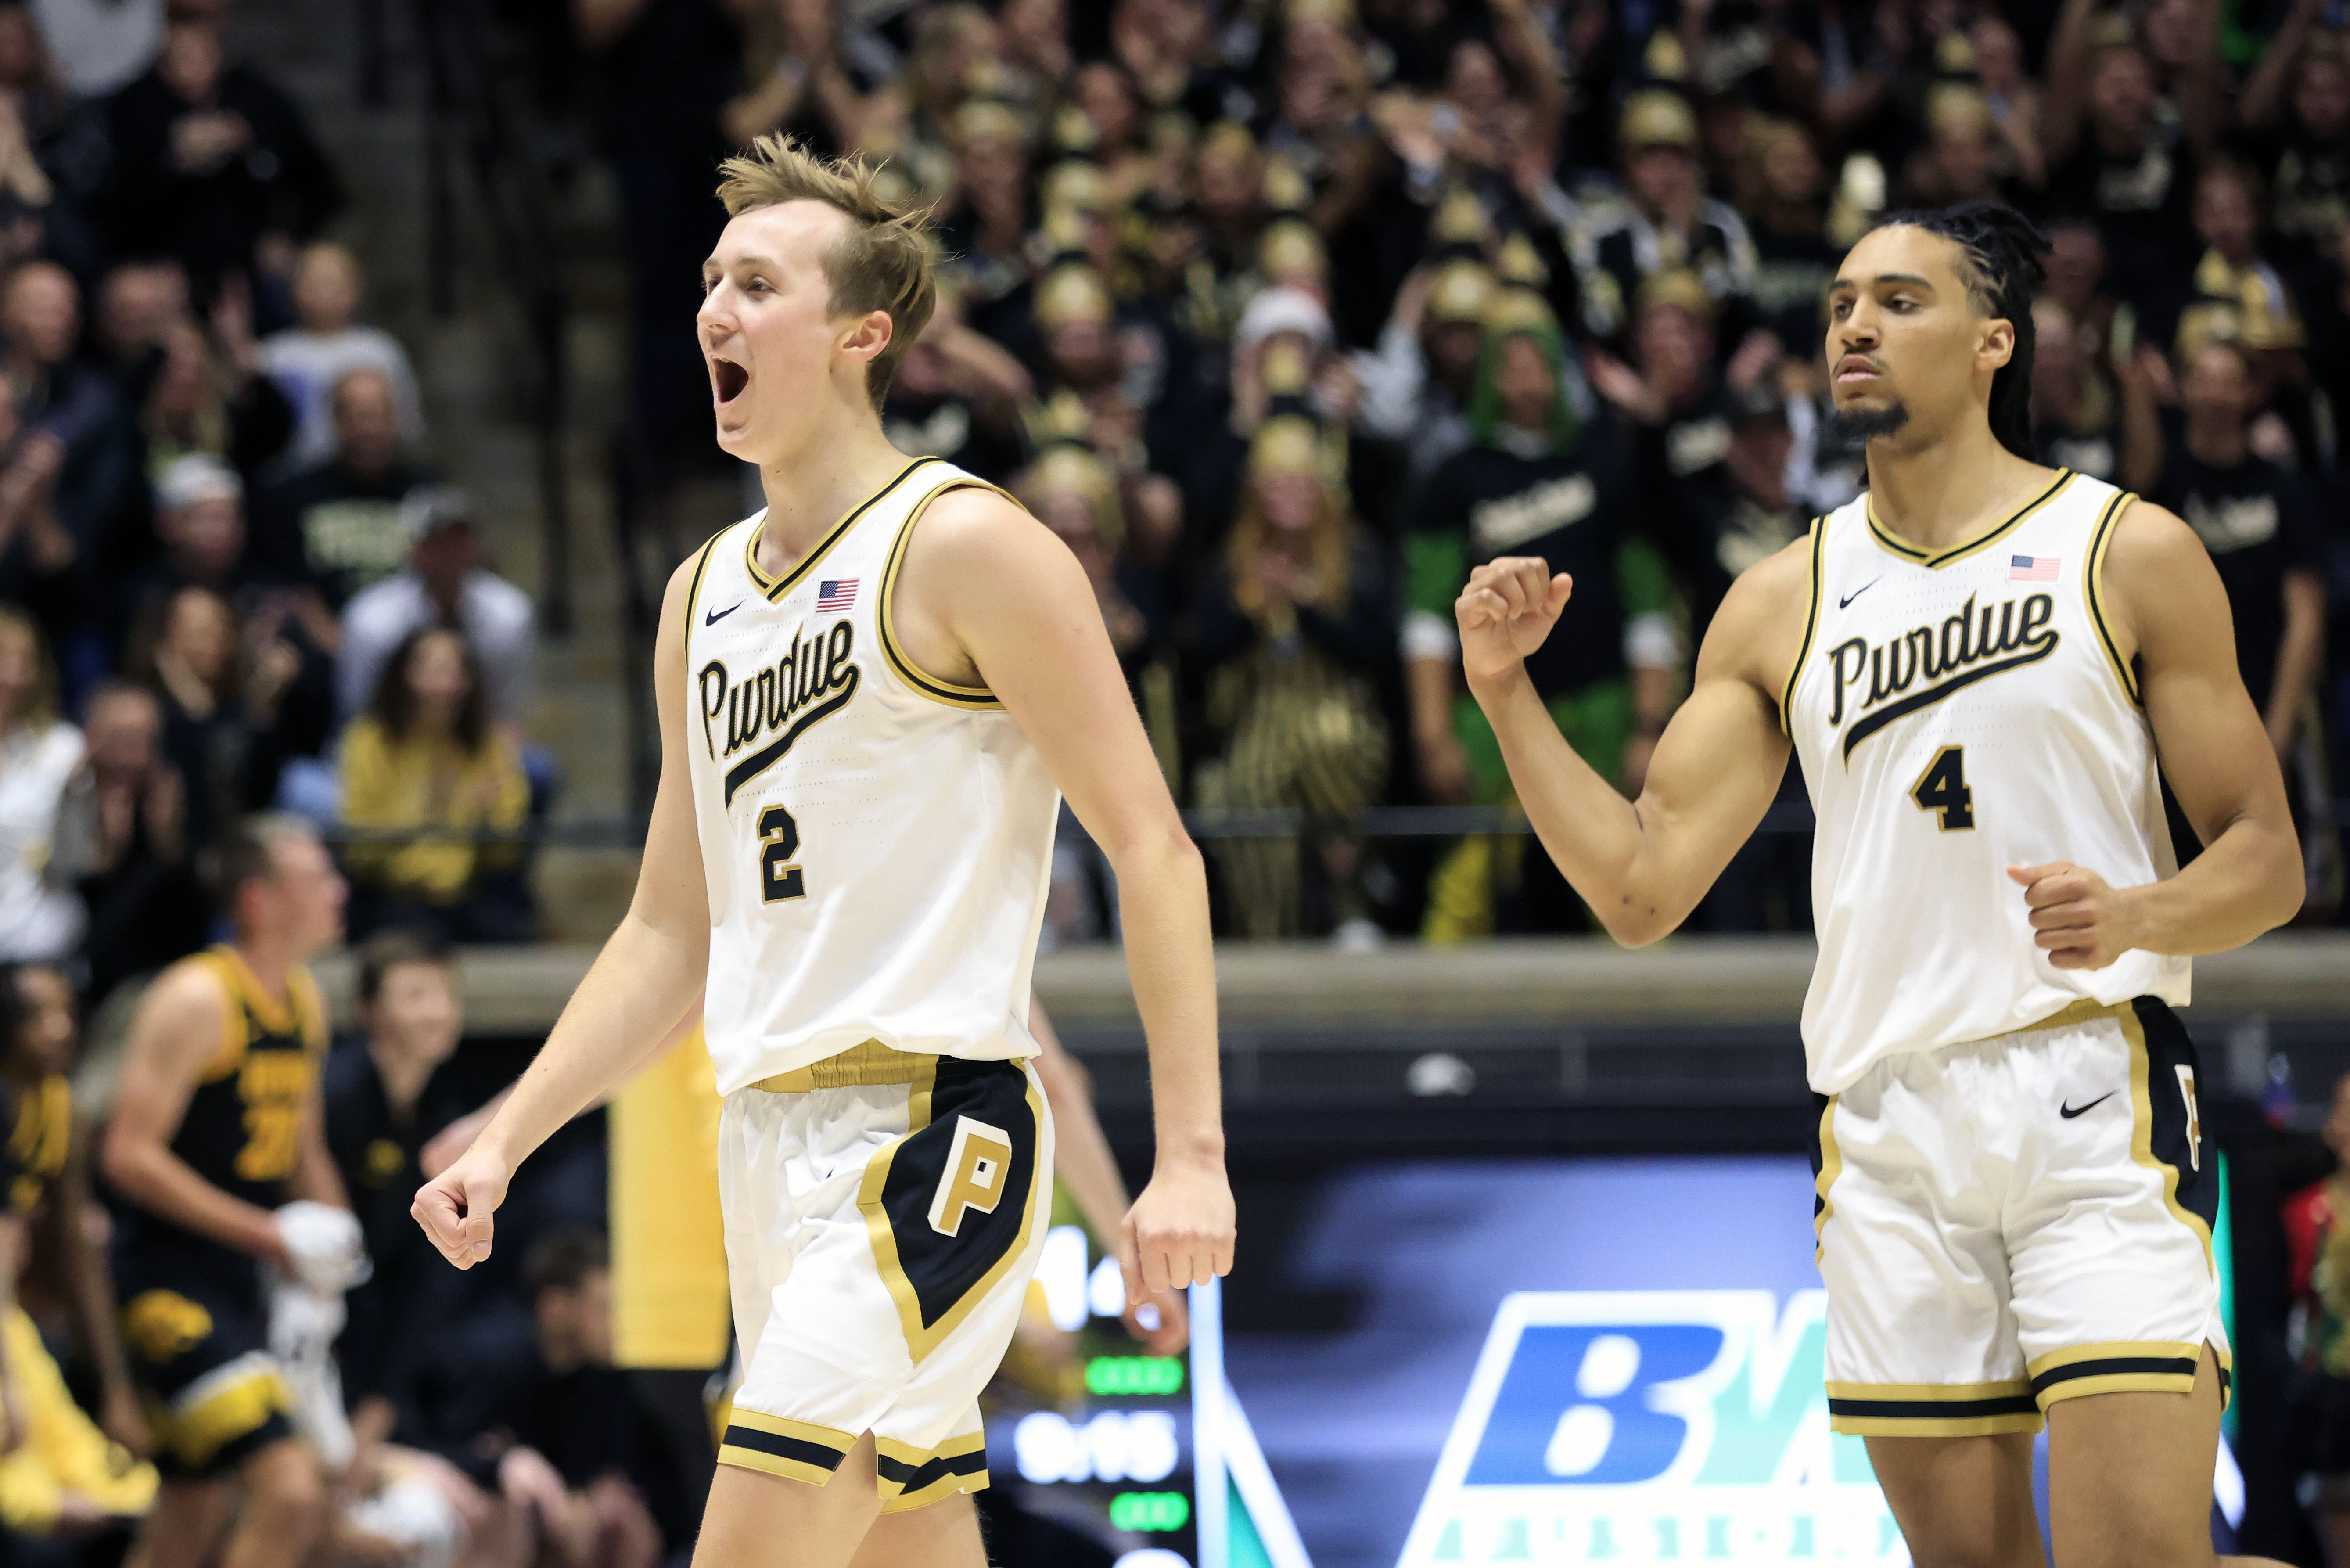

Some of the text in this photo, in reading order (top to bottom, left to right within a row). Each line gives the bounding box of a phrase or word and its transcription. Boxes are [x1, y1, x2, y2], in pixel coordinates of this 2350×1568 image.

[697, 619, 861, 812] Purdue
[1826, 590, 2060, 775] Purdue
[1909, 744, 1976, 833] 4
[756, 804, 806, 905] 2
[927, 1115, 1012, 1238] P
